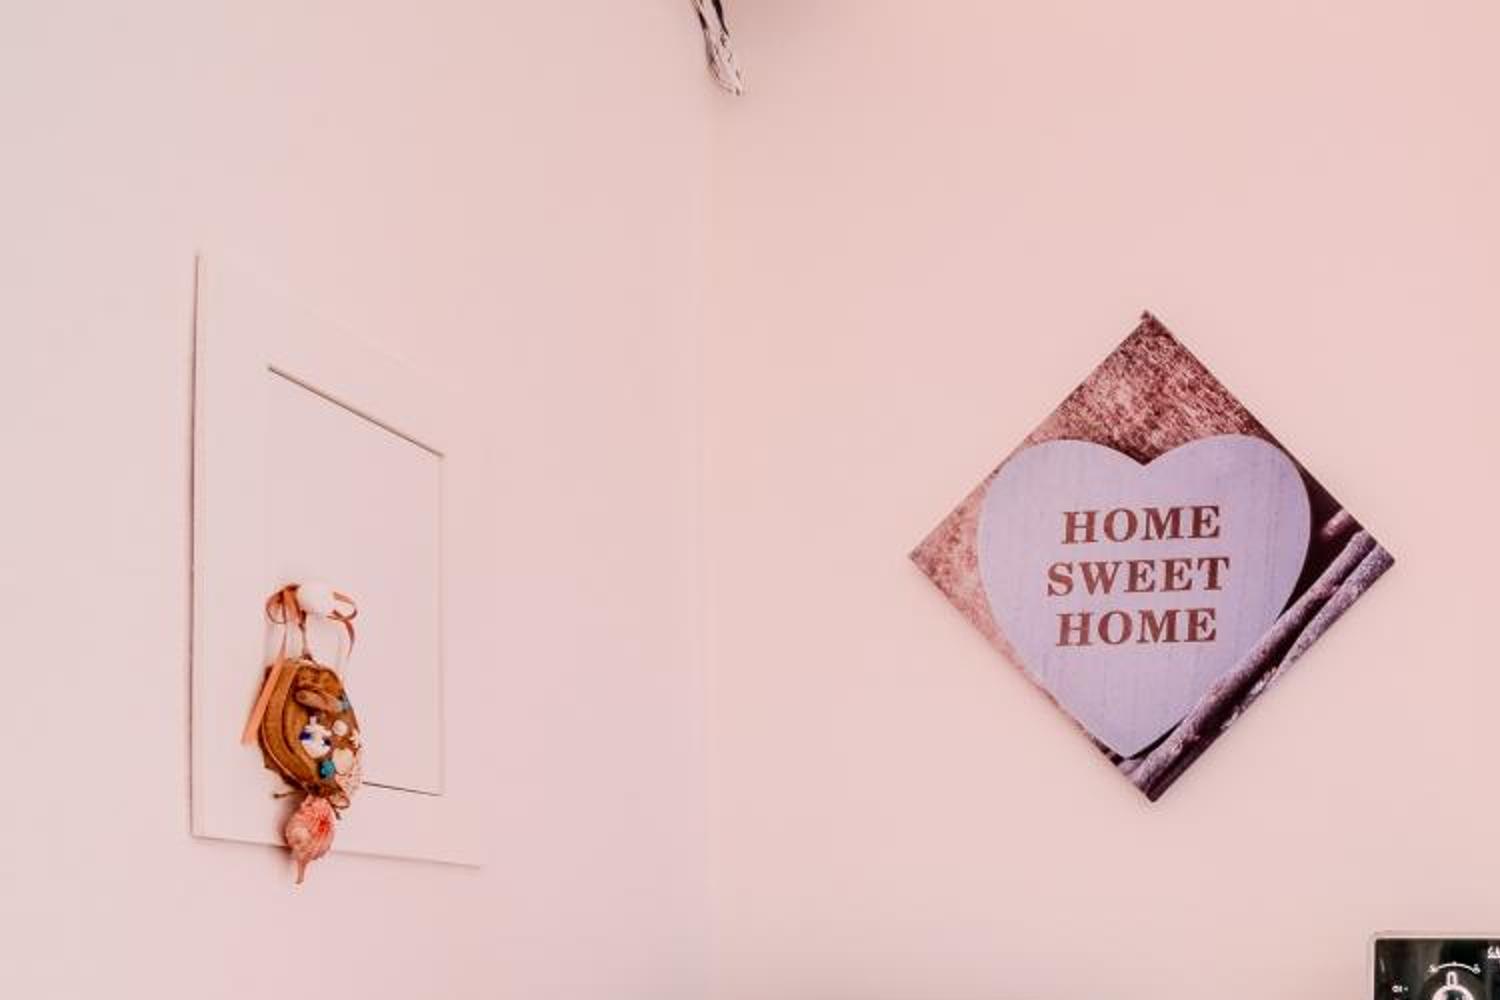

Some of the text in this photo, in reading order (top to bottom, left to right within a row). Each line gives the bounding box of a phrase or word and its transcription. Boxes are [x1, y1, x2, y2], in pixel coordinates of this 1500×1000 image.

[1061, 506, 1221, 544] HOME
[1047, 556, 1230, 597] SWEET
[1055, 607, 1217, 647] HOME
